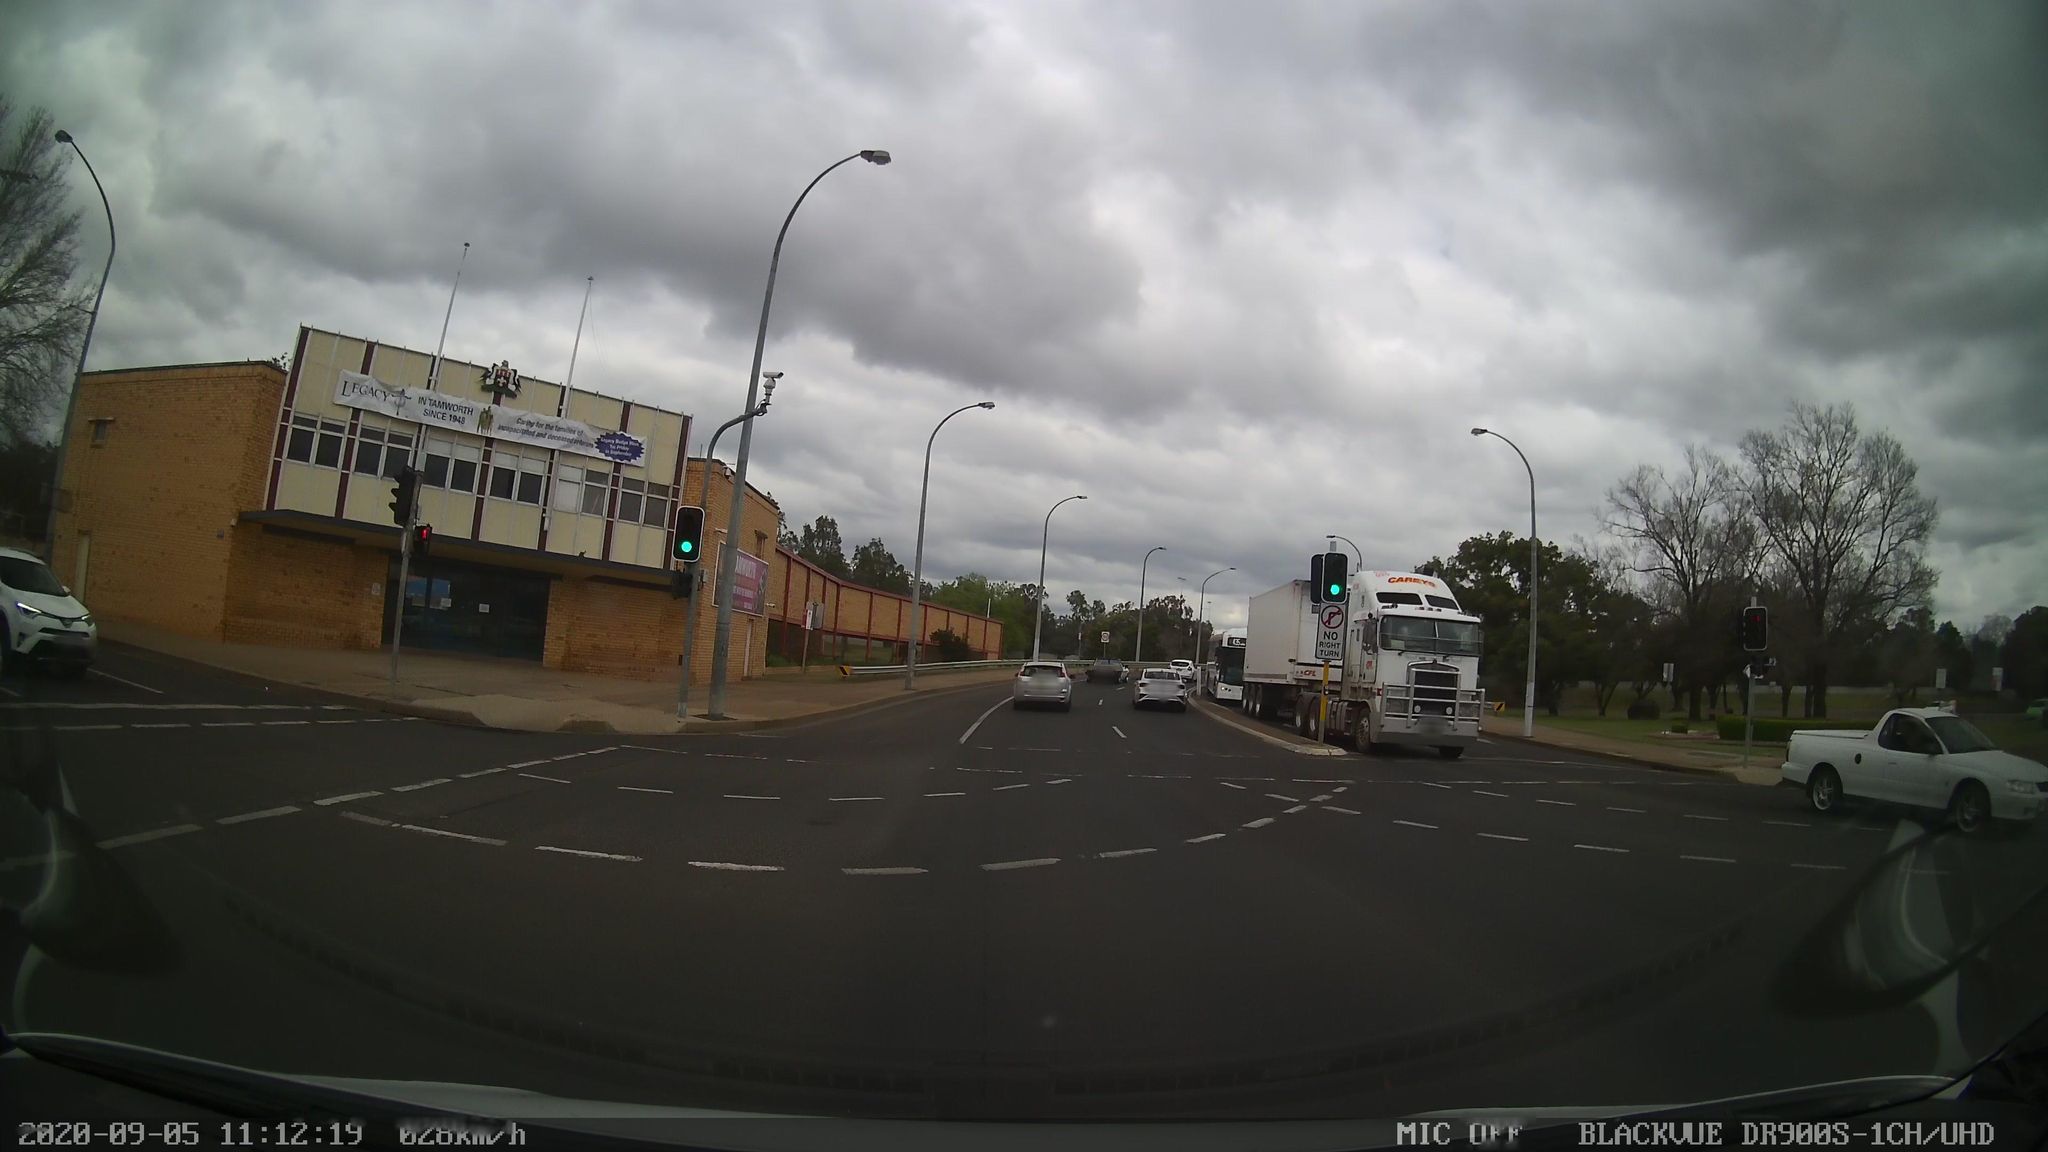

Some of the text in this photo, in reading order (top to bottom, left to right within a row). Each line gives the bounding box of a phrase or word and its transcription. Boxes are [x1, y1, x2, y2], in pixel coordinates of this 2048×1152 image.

[341, 380, 391, 402] LEGACY
[418, 396, 474, 416] IN TAMWORTH
[423, 408, 466, 425] SINCE 1948
[1387, 576, 1436, 588] CAREYS
[1323, 631, 1339, 640] NO
[1318, 641, 1341, 649] RIGHT
[1319, 650, 1340, 658] TURN
